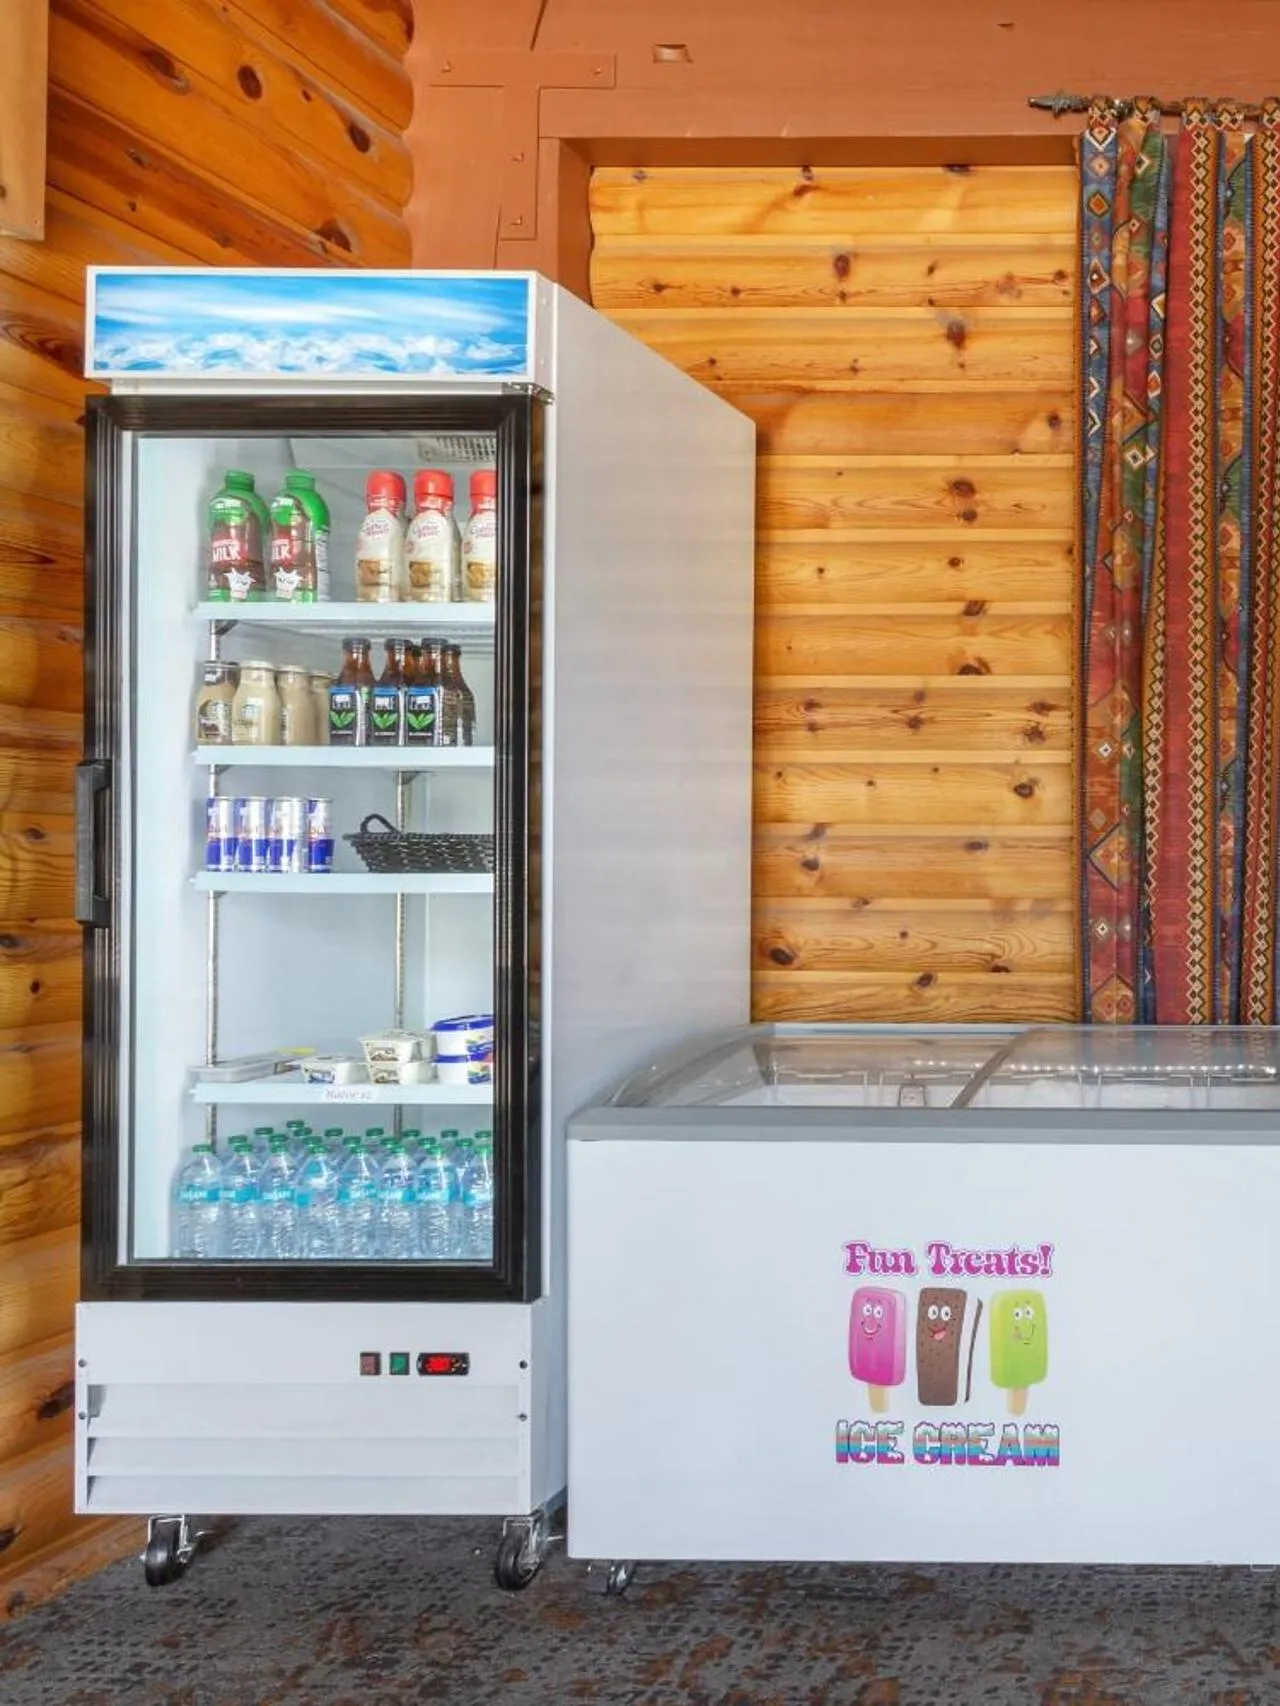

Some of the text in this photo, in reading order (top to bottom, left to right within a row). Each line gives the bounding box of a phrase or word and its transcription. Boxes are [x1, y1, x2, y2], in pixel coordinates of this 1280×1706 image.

[845, 1242, 1053, 1276] Fun Treats!
[836, 1420, 1061, 1467] ICE CREAM
